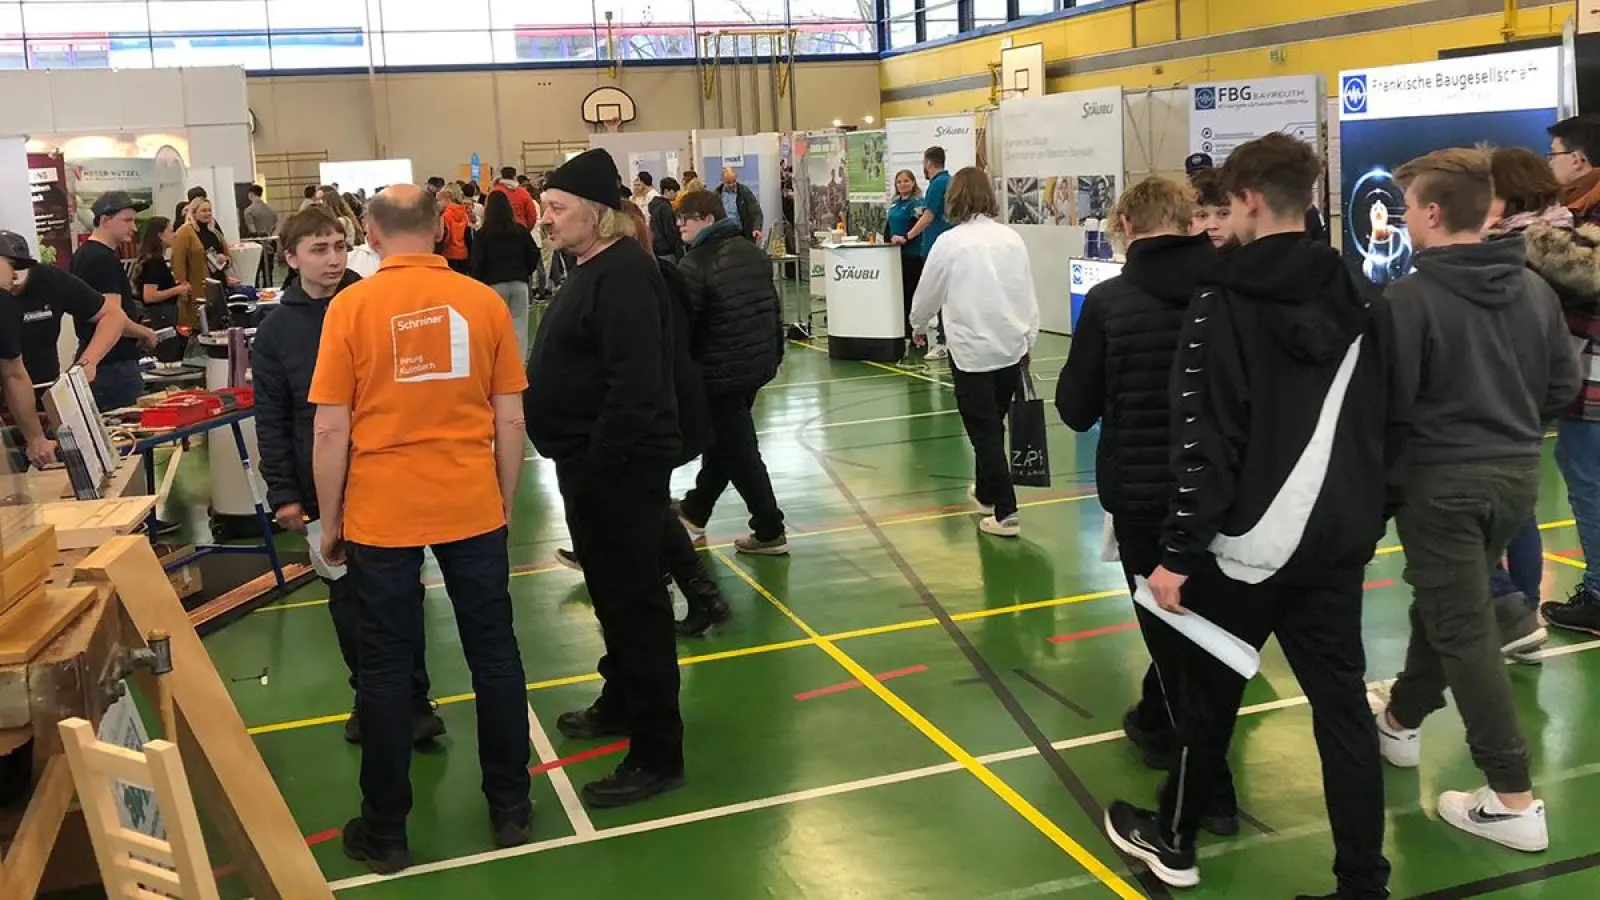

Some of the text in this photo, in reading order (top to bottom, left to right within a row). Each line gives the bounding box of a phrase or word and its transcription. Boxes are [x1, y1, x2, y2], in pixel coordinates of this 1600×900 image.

[1435, 64, 1538, 90] Baugesellsca
[1218, 85, 1305, 102] FBG BAYREUTH
[1081, 102, 1114, 119] STÄUBLI
[934, 126, 969, 138] STÄUBLI
[833, 264, 880, 281] STÄUBLI
[397, 315, 443, 332] Schreiner
